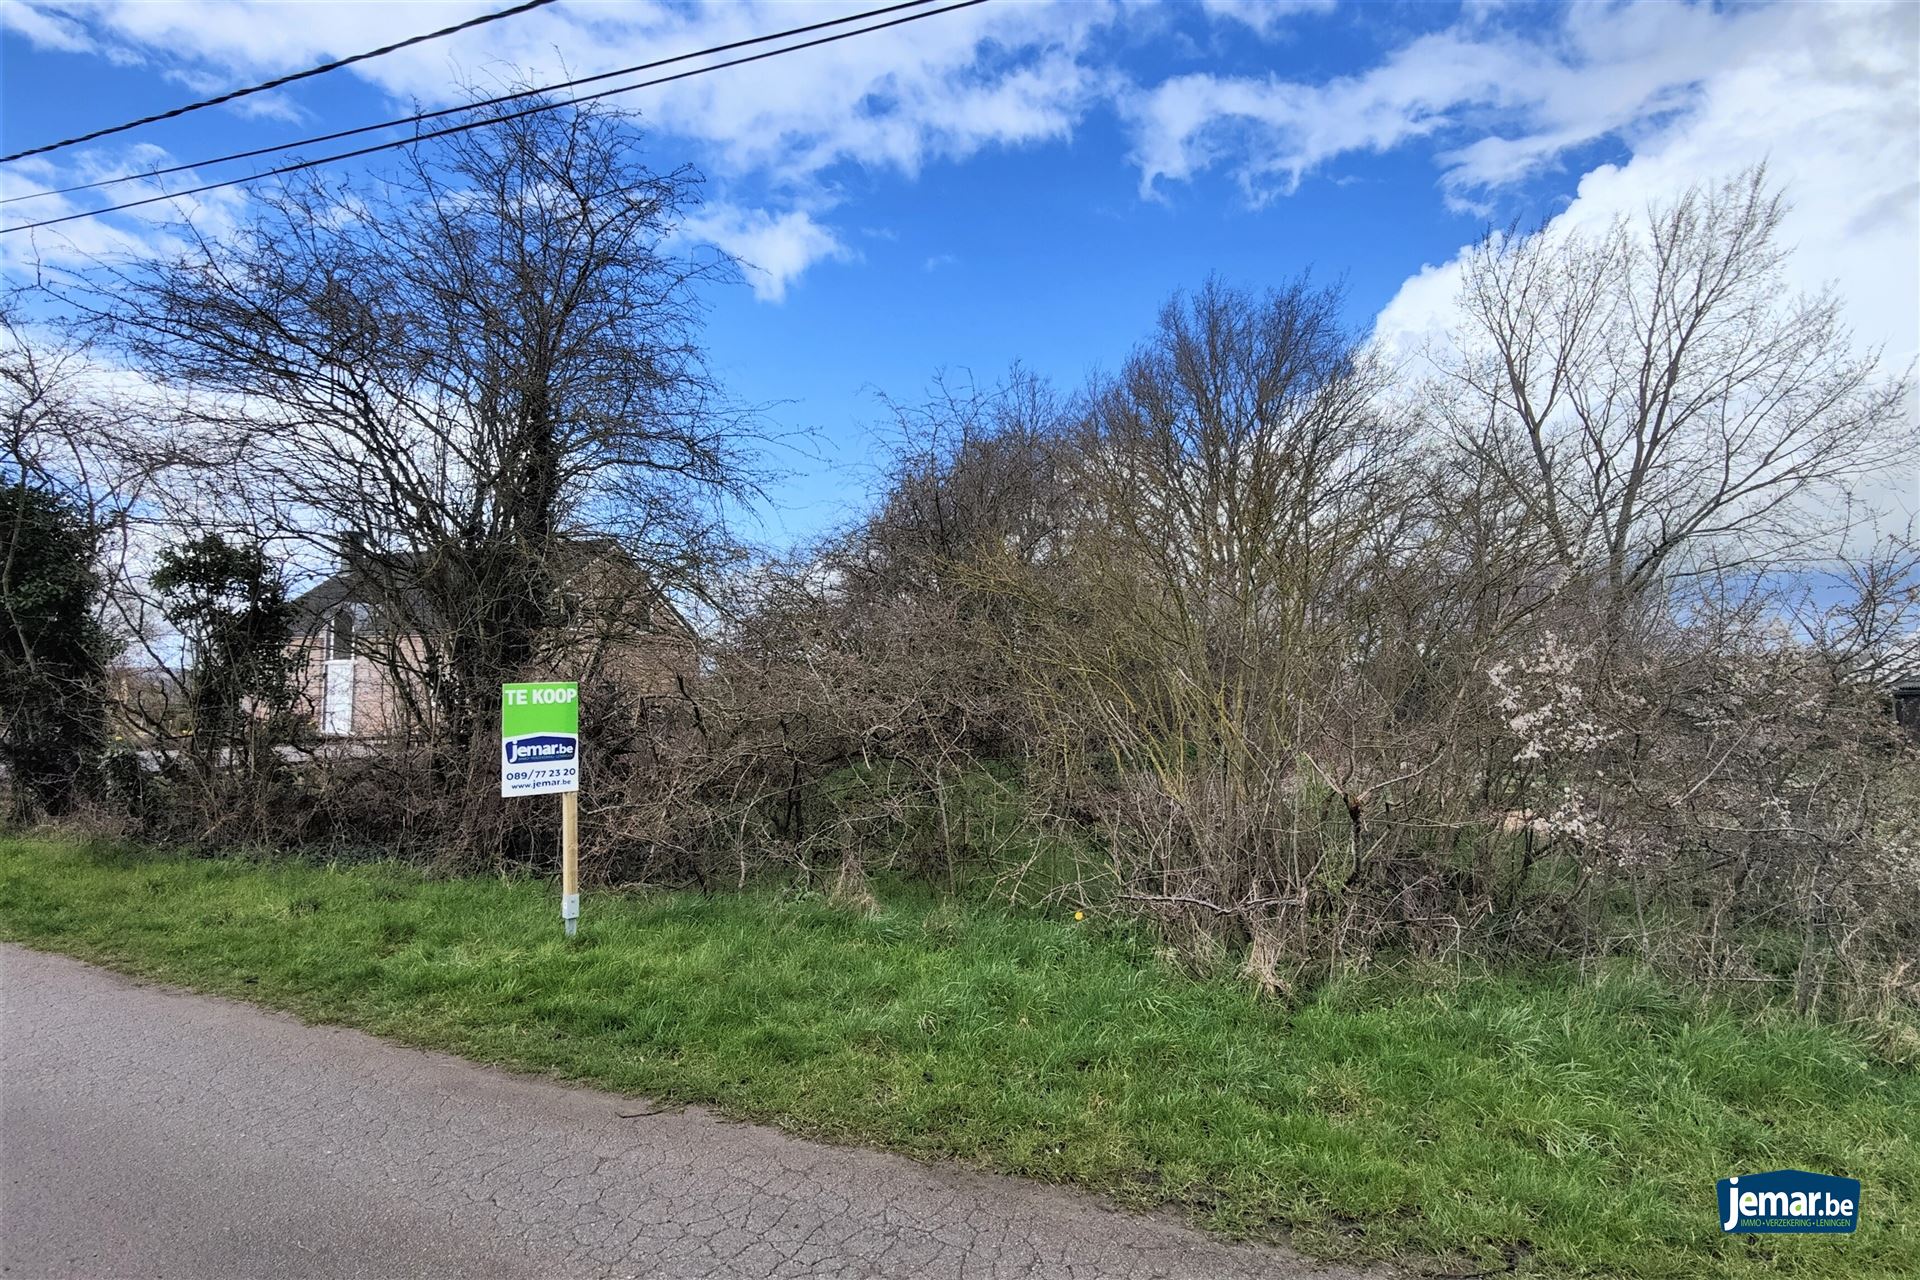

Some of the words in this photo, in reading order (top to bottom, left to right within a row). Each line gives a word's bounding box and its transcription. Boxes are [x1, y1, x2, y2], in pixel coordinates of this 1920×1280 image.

[505, 689, 528, 705] TE
[532, 688, 577, 704] KOOP
[509, 740, 573, 763] jemar.be
[506, 769, 546, 780] 089/77
[549, 769, 561, 777] 23
[563, 768, 576, 776] 20
[511, 779, 572, 789] www.jemar.be
